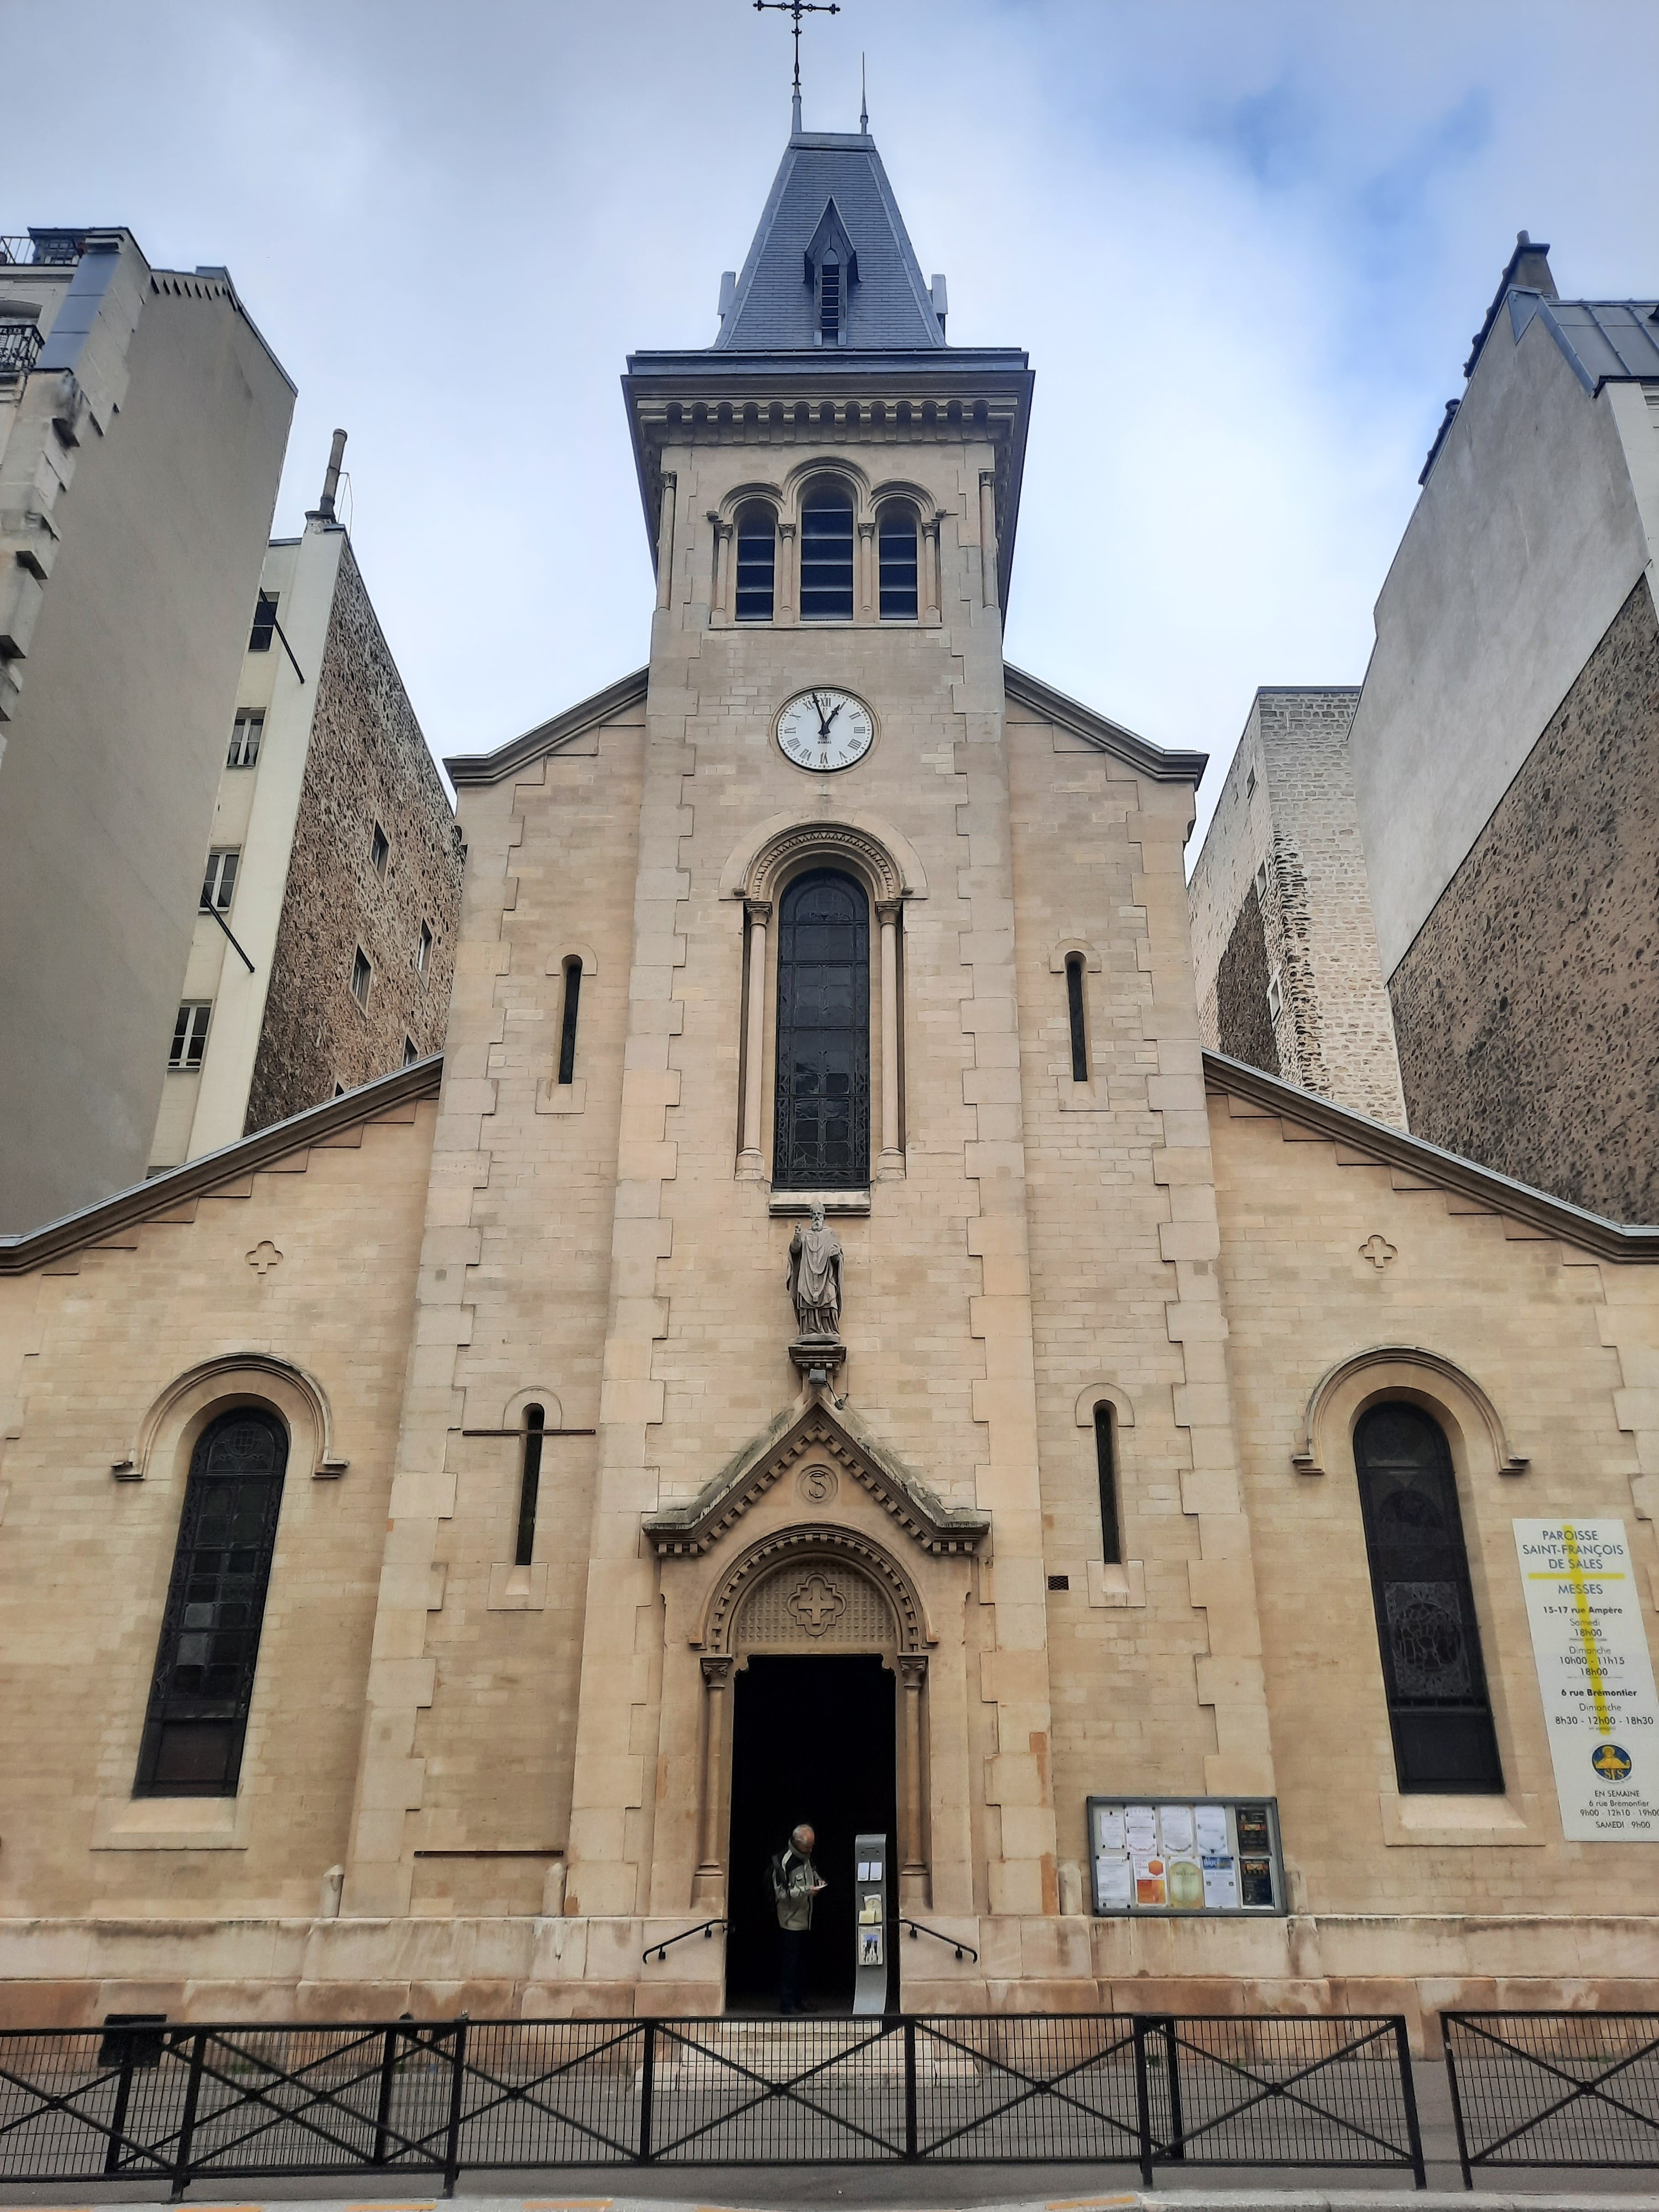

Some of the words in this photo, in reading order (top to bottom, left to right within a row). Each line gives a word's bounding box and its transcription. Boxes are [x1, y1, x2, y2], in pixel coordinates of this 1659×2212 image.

[802, 700, 815, 712] XI
[821, 697, 831, 707] XII
[789, 712, 801, 721] X
[849, 712, 862, 721] II
[854, 726, 865, 734] III
[787, 738, 802, 752] VIII
[847, 738, 862, 751] IIII
[799, 748, 812, 761] VII
[820, 752, 828, 764] VI
[839, 750, 848, 761] V
[1542, 1530, 1599, 1541] PAROISSE
[1522, 1545, 1624, 1557] SAINT-FRANÇOIS
[1548, 1558, 1565, 1569] DE
[1569, 1559, 1603, 1569] SALES
[1558, 1584, 1603, 1595] MESSES
[1589, 1606, 1623, 1616] Ampère
[1574, 1629, 1603, 1637] 18h00
[1569, 1646, 1611, 1655] Dimanche
[1559, 1656, 1587, 1665] 10h00
[1598, 1656, 1625, 1665] 11h15
[1580, 1667, 1608, 1676] 18h00
[1579, 1703, 1622, 1712] Dimanche
[1555, 1716, 1578, 1725] 8h30
[1588, 1716, 1616, 1725] 12h00
[1625, 1716, 1654, 1725] 18h30
